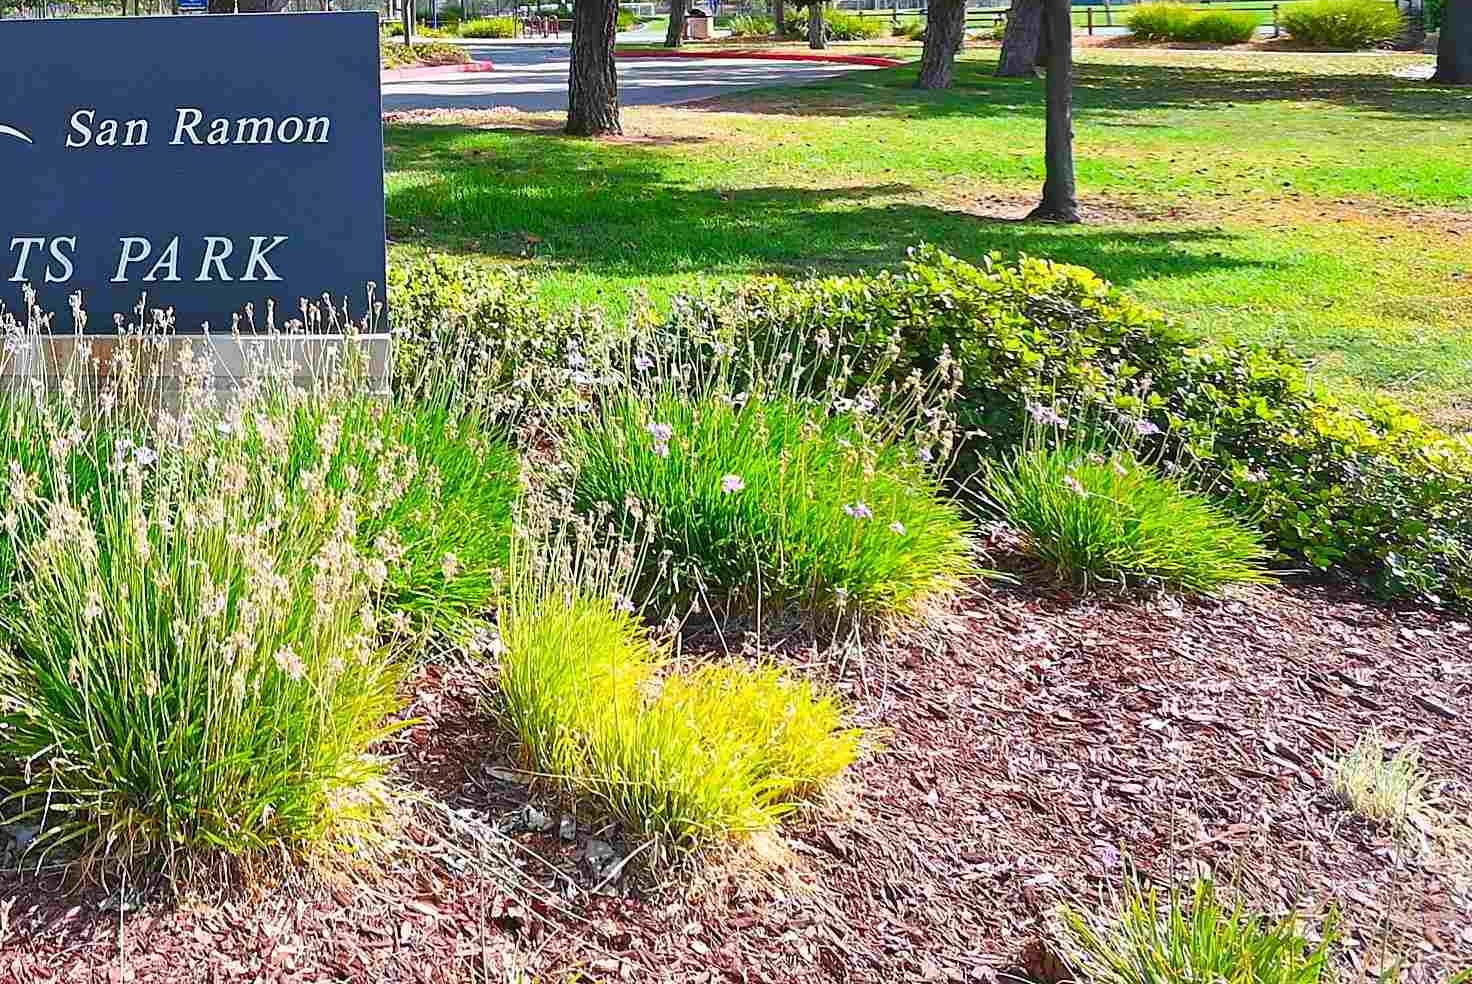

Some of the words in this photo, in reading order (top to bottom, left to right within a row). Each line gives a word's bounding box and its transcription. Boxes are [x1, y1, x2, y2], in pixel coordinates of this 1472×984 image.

[65, 110, 150, 149] San
[168, 107, 331, 147] Ramon
[110, 235, 290, 283] PARK
